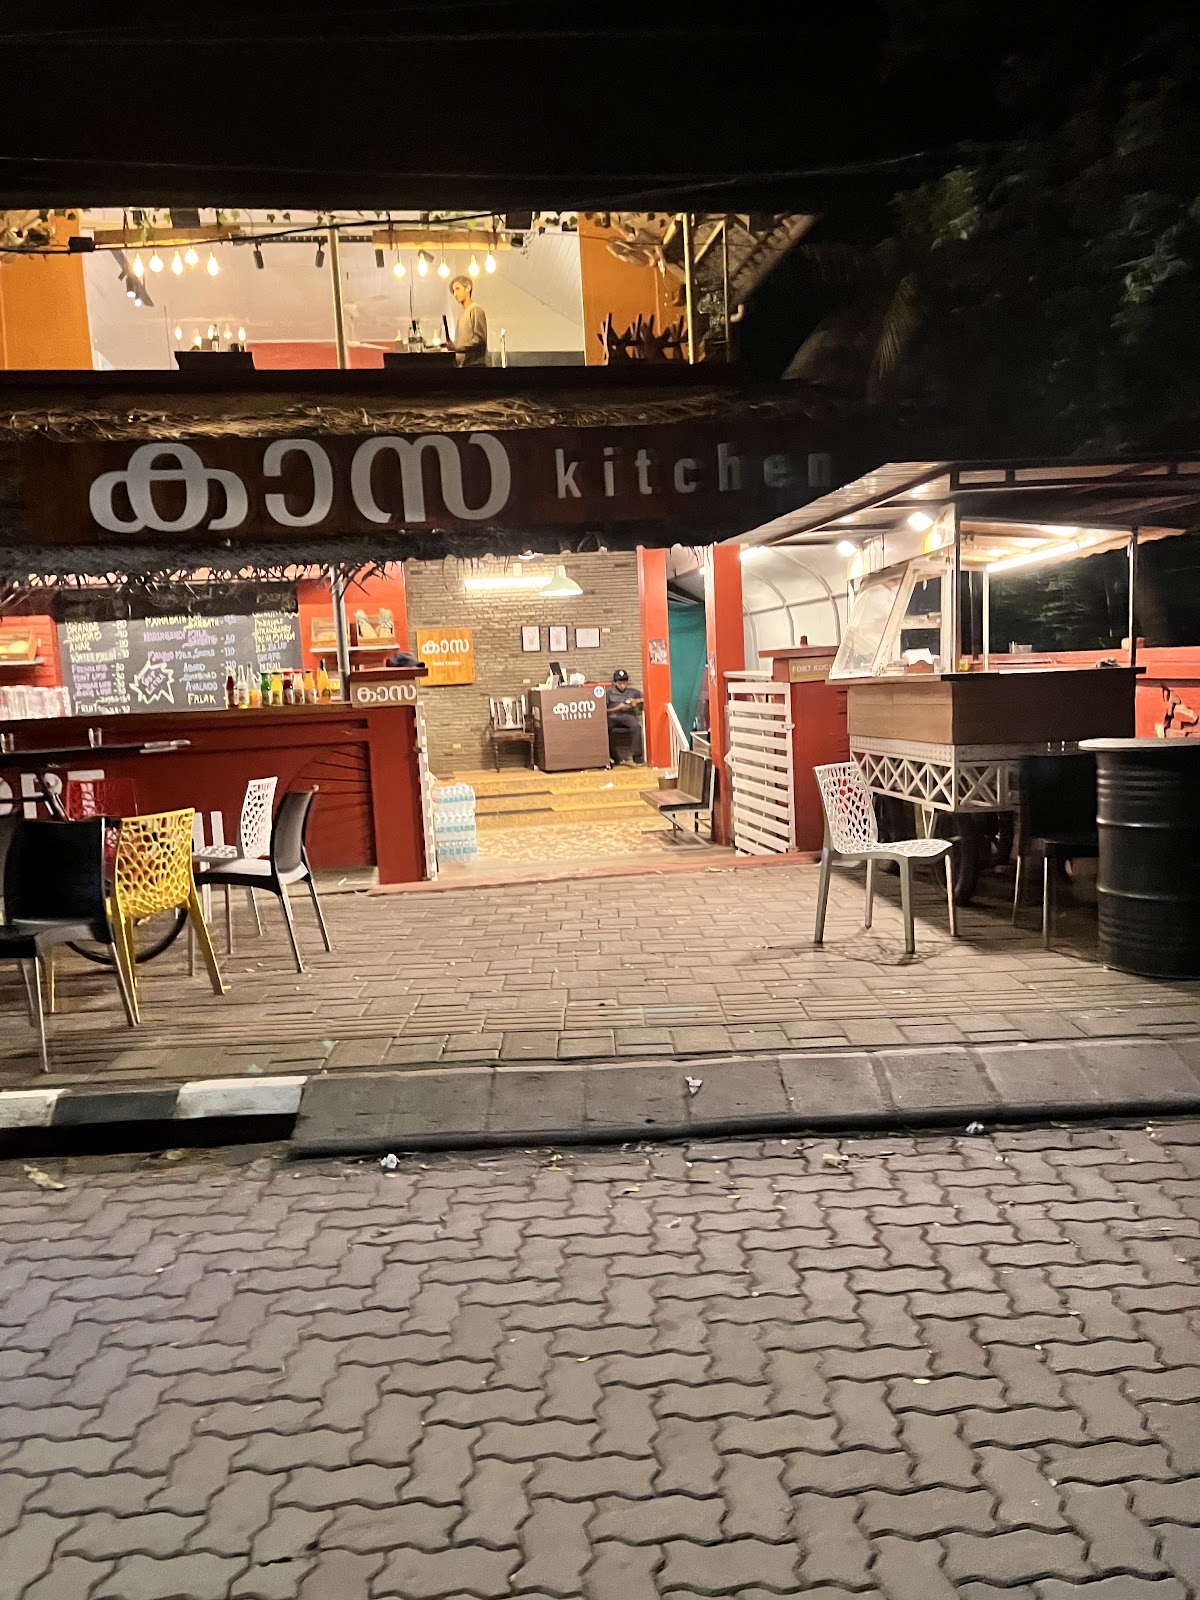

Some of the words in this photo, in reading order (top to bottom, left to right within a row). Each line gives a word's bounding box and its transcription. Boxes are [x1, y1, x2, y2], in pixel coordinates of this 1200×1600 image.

[554, 442, 834, 500] kitchen
[89, 434, 511, 534] കാസ
[421, 638, 470, 655] കാസ
[813, 664, 832, 672] KOC
[187, 693, 216, 705] FALAK
[357, 684, 417, 703] കാസ
